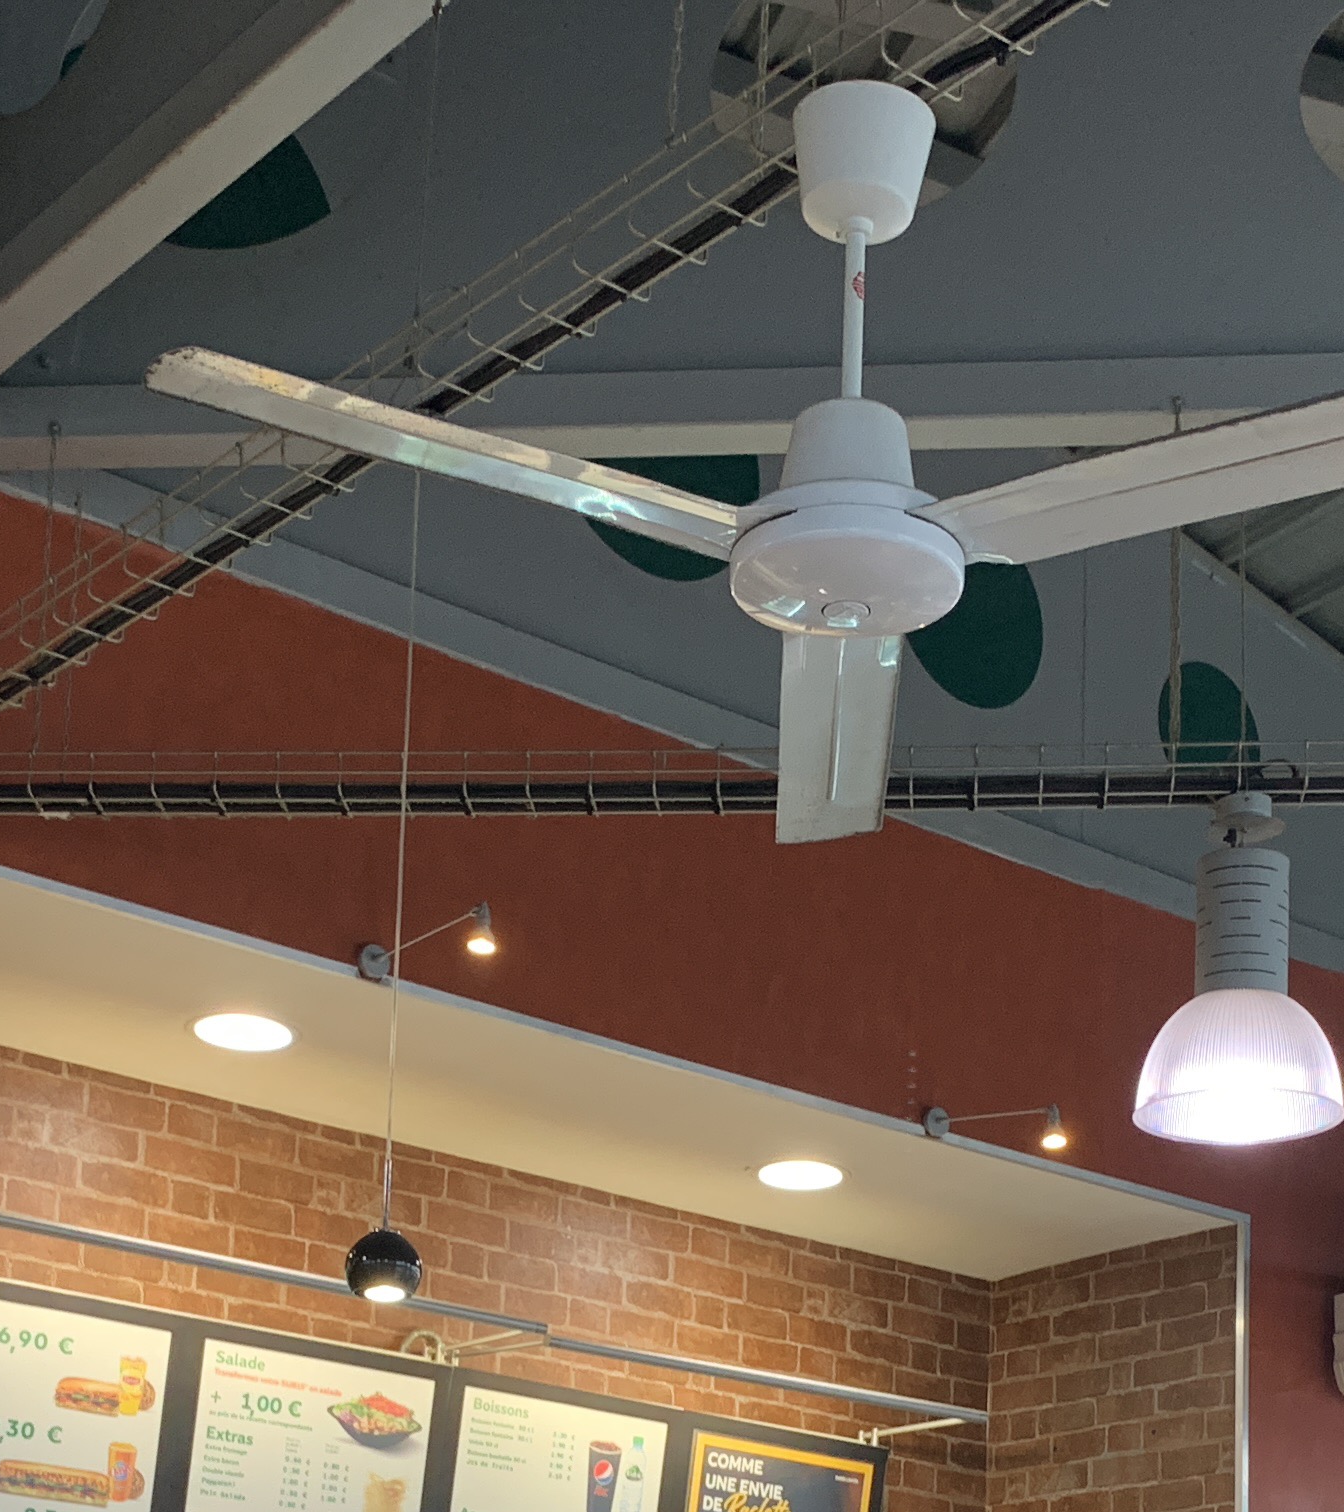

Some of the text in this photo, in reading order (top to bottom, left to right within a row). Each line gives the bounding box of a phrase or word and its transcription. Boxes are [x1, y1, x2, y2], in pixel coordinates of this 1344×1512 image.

[59, 1337, 75, 1355] €
[215, 1350, 266, 1371] Salade
[210, 1391, 303, 1418] + 1,00 €
[473, 1398, 529, 1419] Boissons
[47, 1425, 63, 1444] €
[206, 1425, 254, 1446] Extras
[707, 1451, 764, 1476] COMME
[705, 1473, 784, 1500] UNE ENVIE
[702, 1495, 723, 1512] DE
